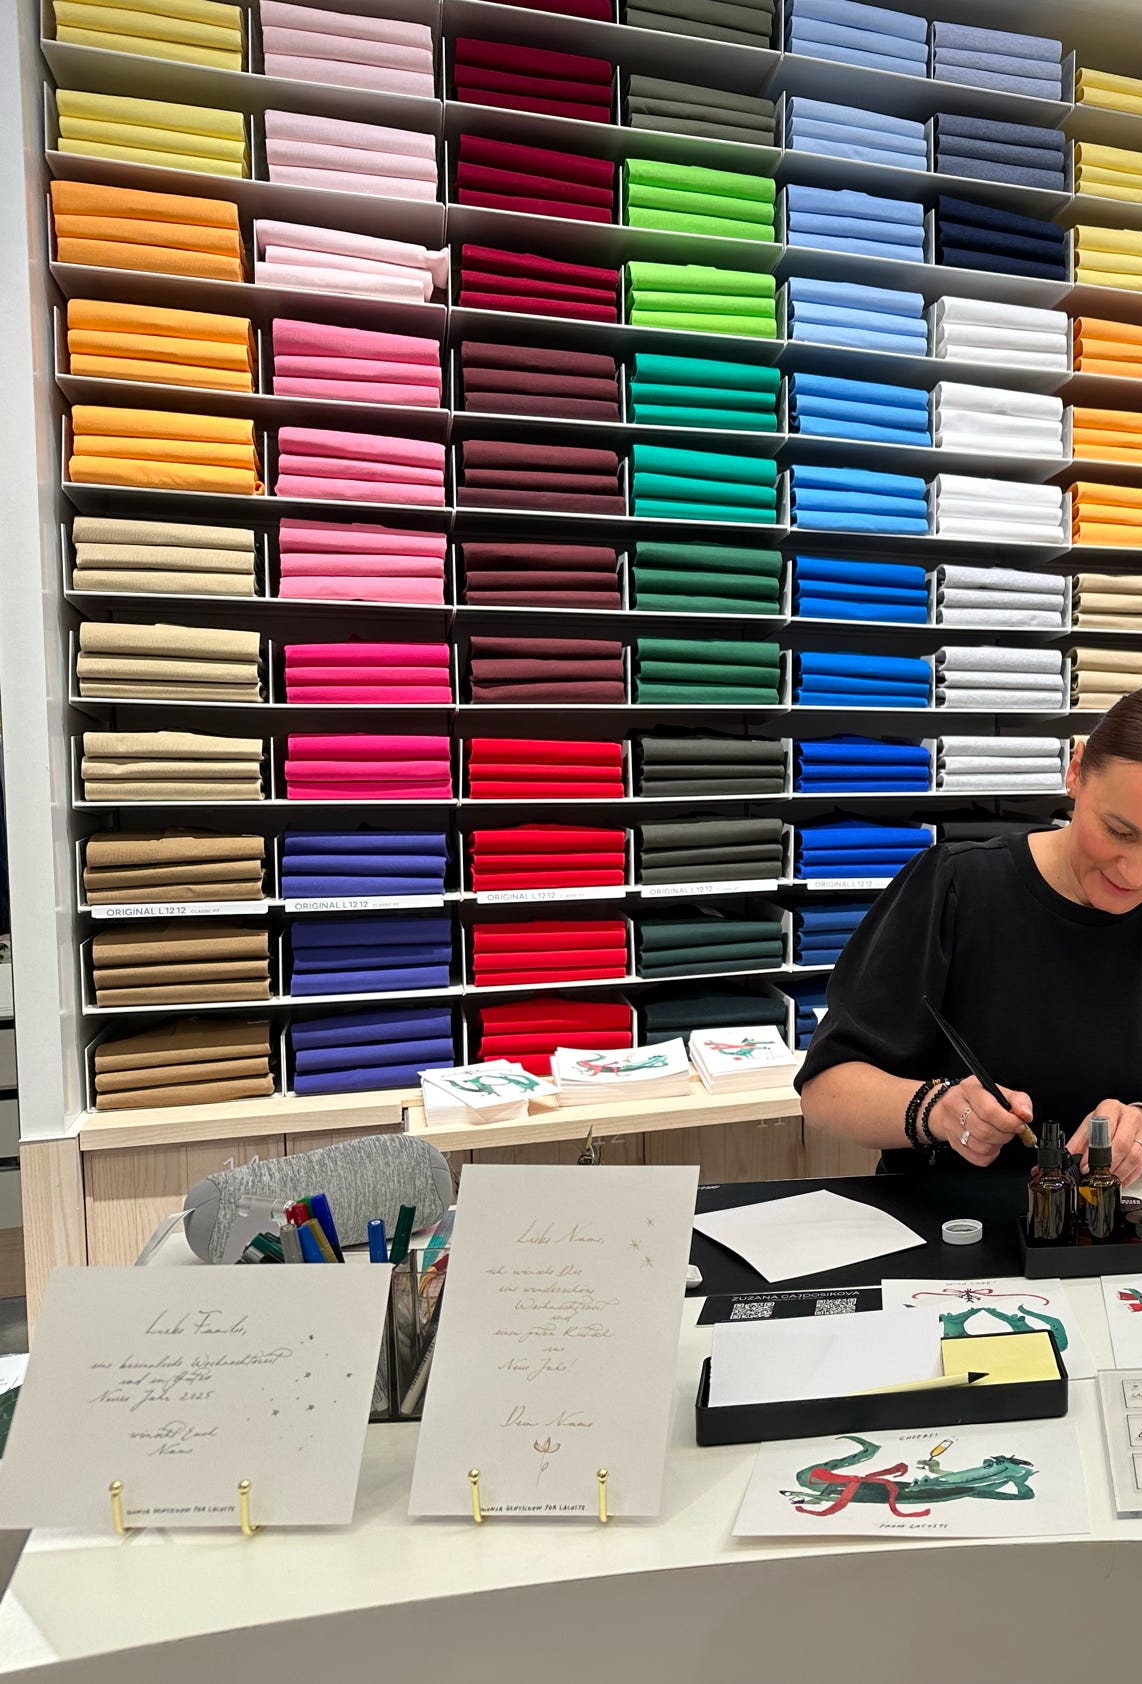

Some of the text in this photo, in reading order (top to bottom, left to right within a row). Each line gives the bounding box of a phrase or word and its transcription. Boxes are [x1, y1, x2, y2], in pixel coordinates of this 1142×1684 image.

[649, 886, 689, 896] ORIGINAL
[487, 892, 529, 901] ORIGINAL
[295, 902, 341, 911] ORIGINAL
[106, 908, 157, 917] ORIGINAL
[178, 1390, 216, 1402] 2025
